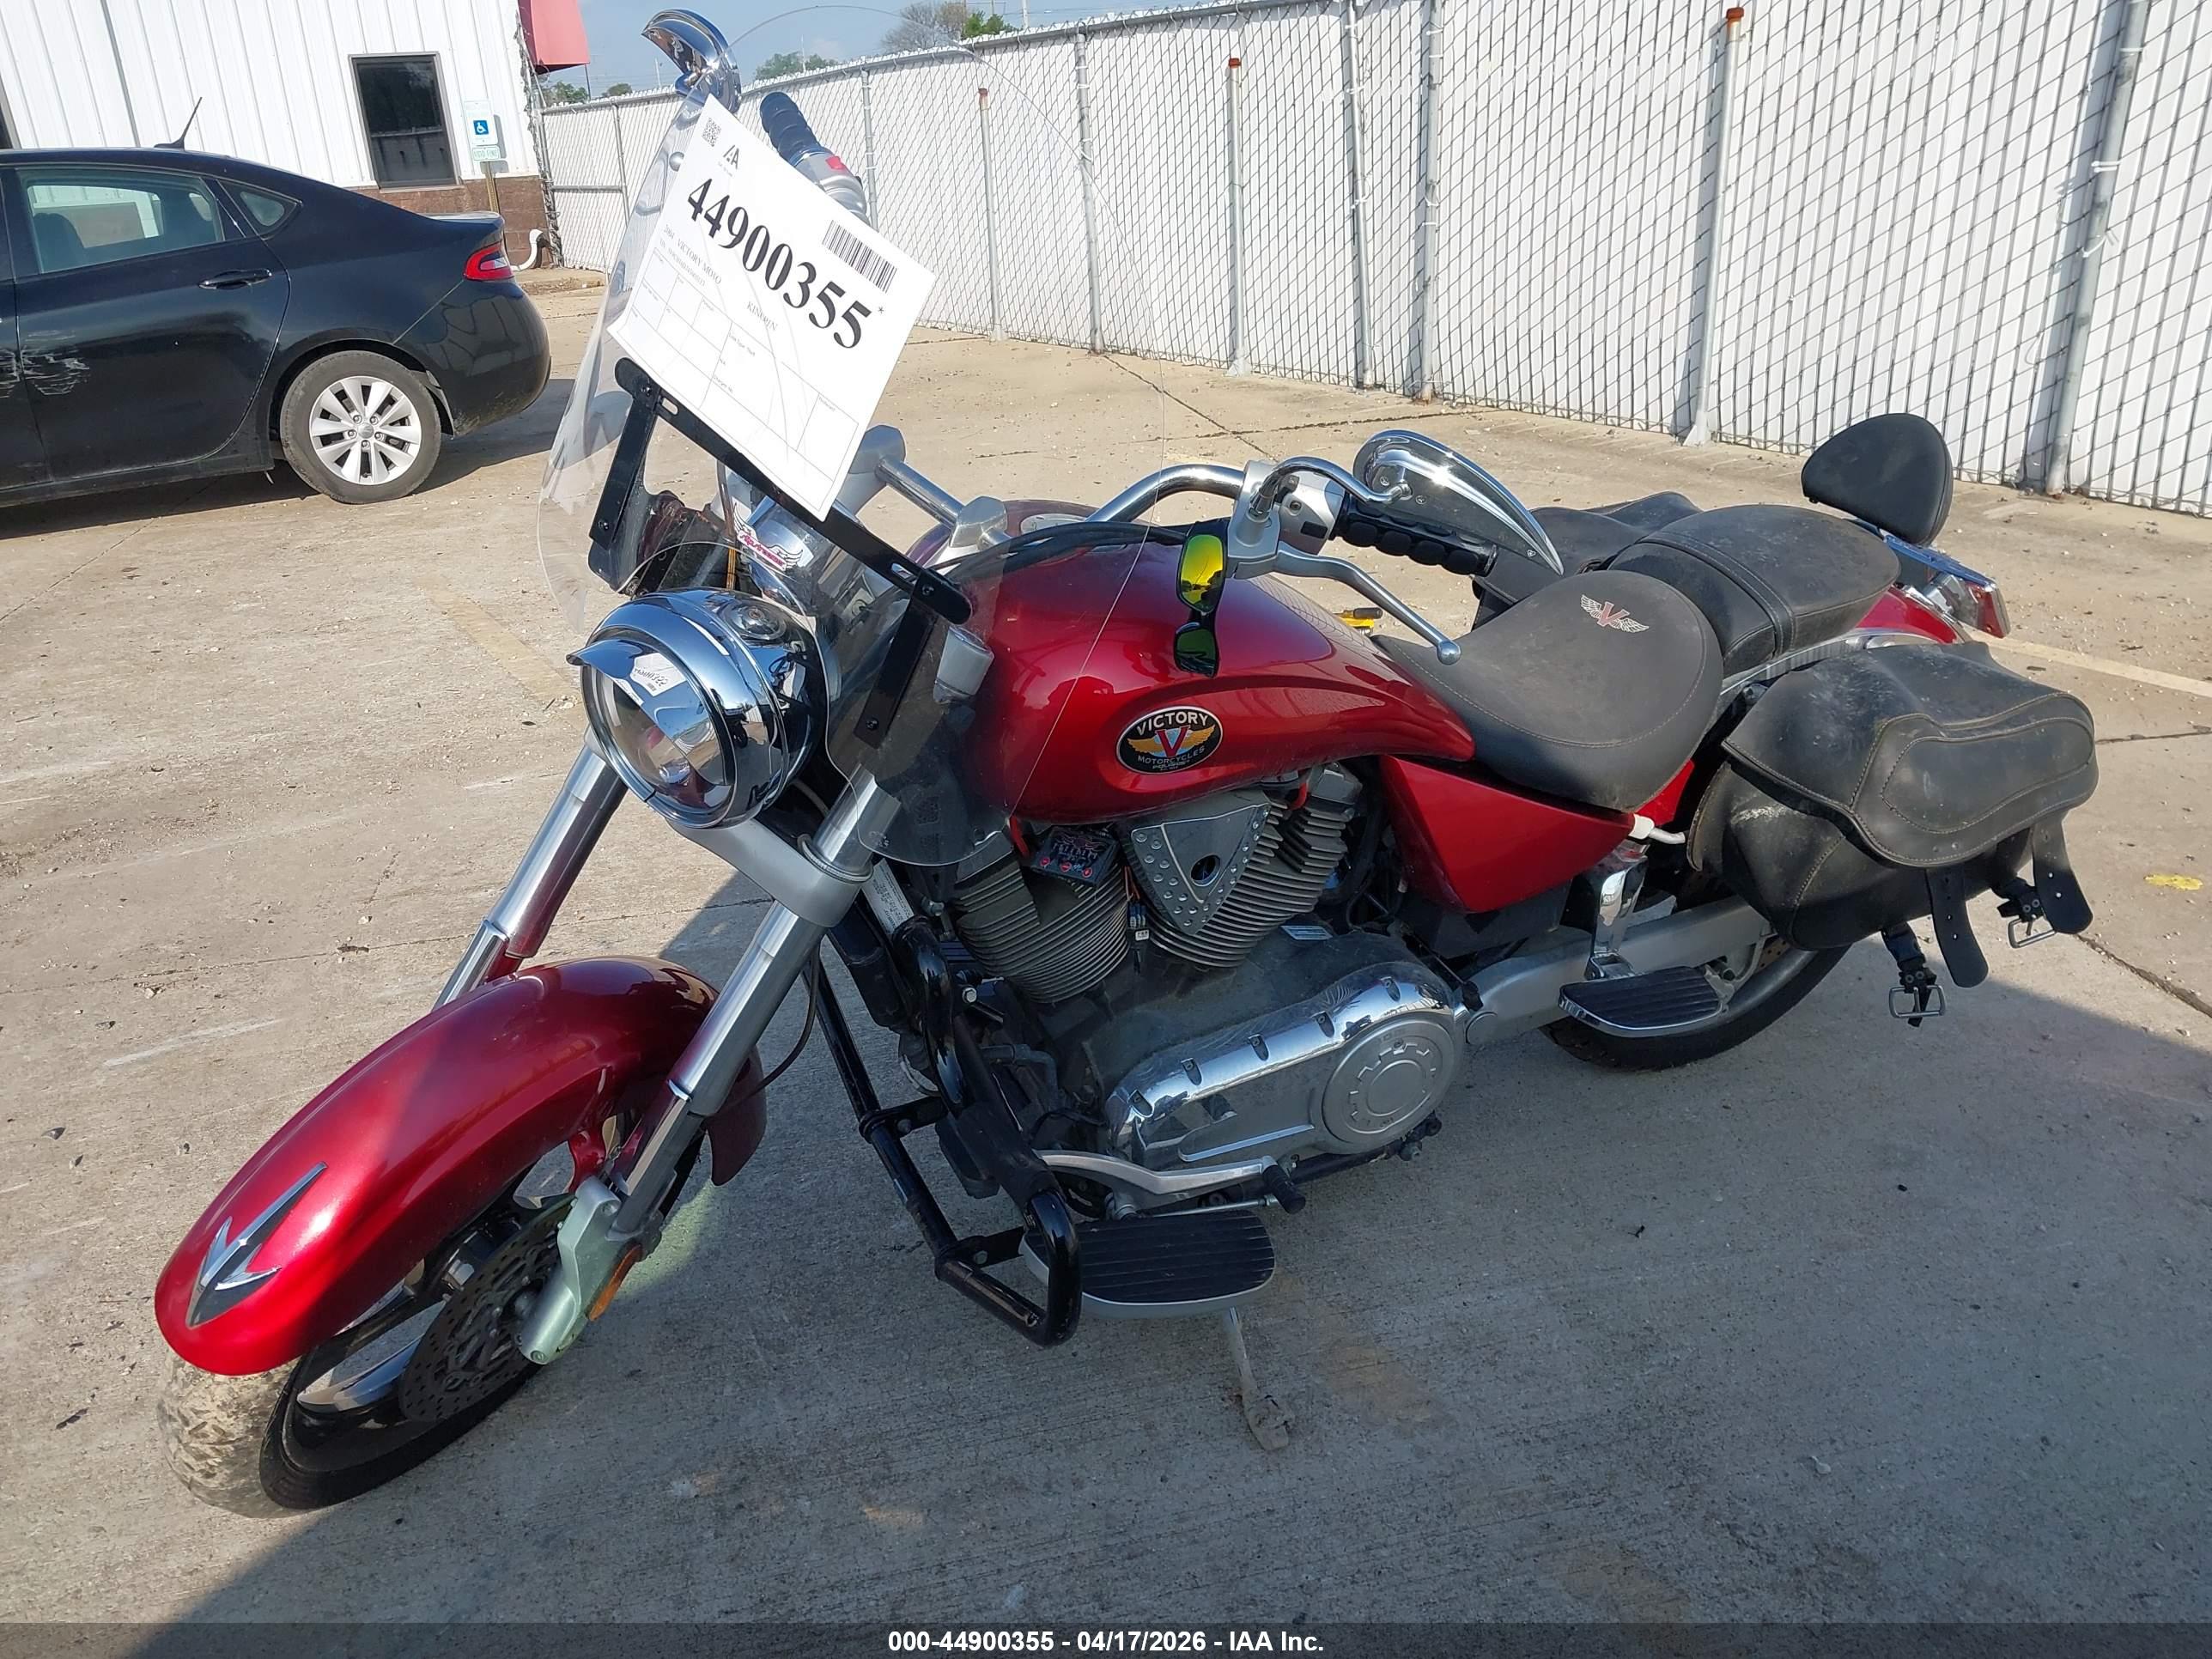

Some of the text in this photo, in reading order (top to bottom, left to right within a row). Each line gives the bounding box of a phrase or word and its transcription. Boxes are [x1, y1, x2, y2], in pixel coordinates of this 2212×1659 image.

[678, 238, 702, 267] VICTORY
[687, 179, 872, 349] 44900355
[1136, 711, 1209, 736] VICTORY
[1137, 745, 1206, 764] MOTORCYCLES
